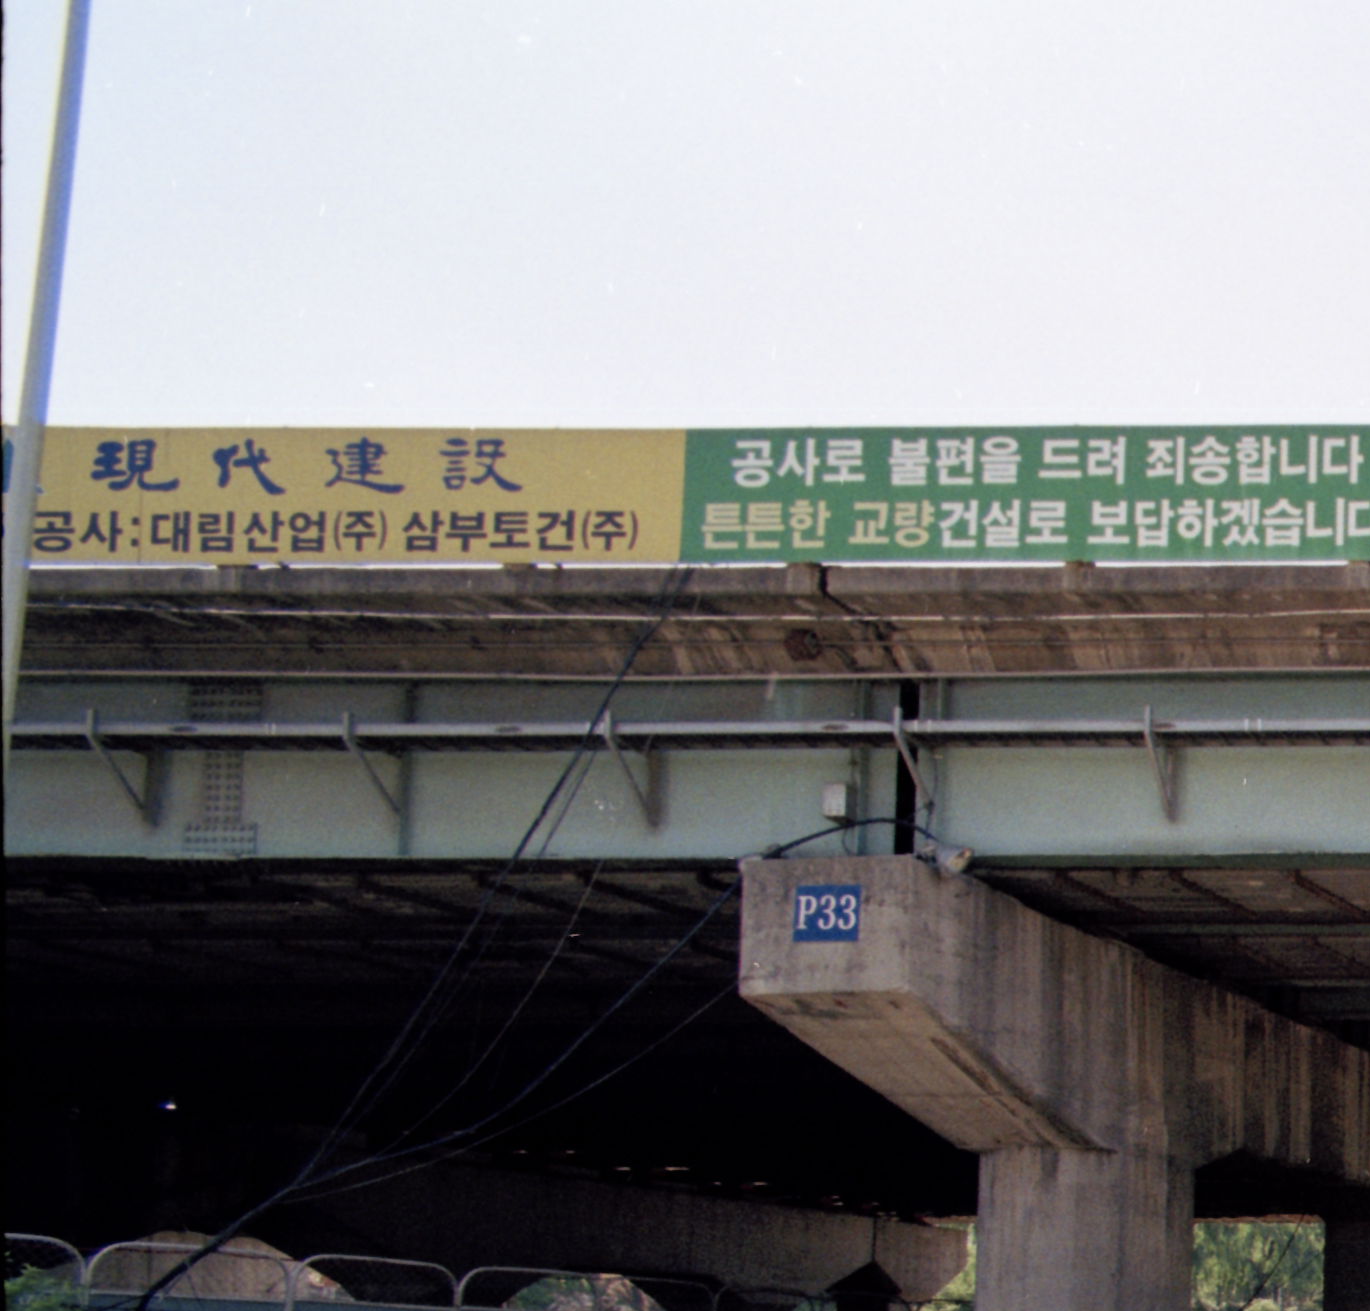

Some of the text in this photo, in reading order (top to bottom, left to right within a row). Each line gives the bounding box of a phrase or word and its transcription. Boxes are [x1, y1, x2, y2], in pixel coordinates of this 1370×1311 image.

[91, 437, 523, 495] 現代建設
[731, 435, 1365, 488] 공사로 불편을 드려 죄송합니다
[402, 510, 639, 552] 삼부토건(주)
[701, 499, 832, 550] 튼튼한
[848, 498, 1068, 548] 교량건설로
[796, 894, 858, 931] P33
